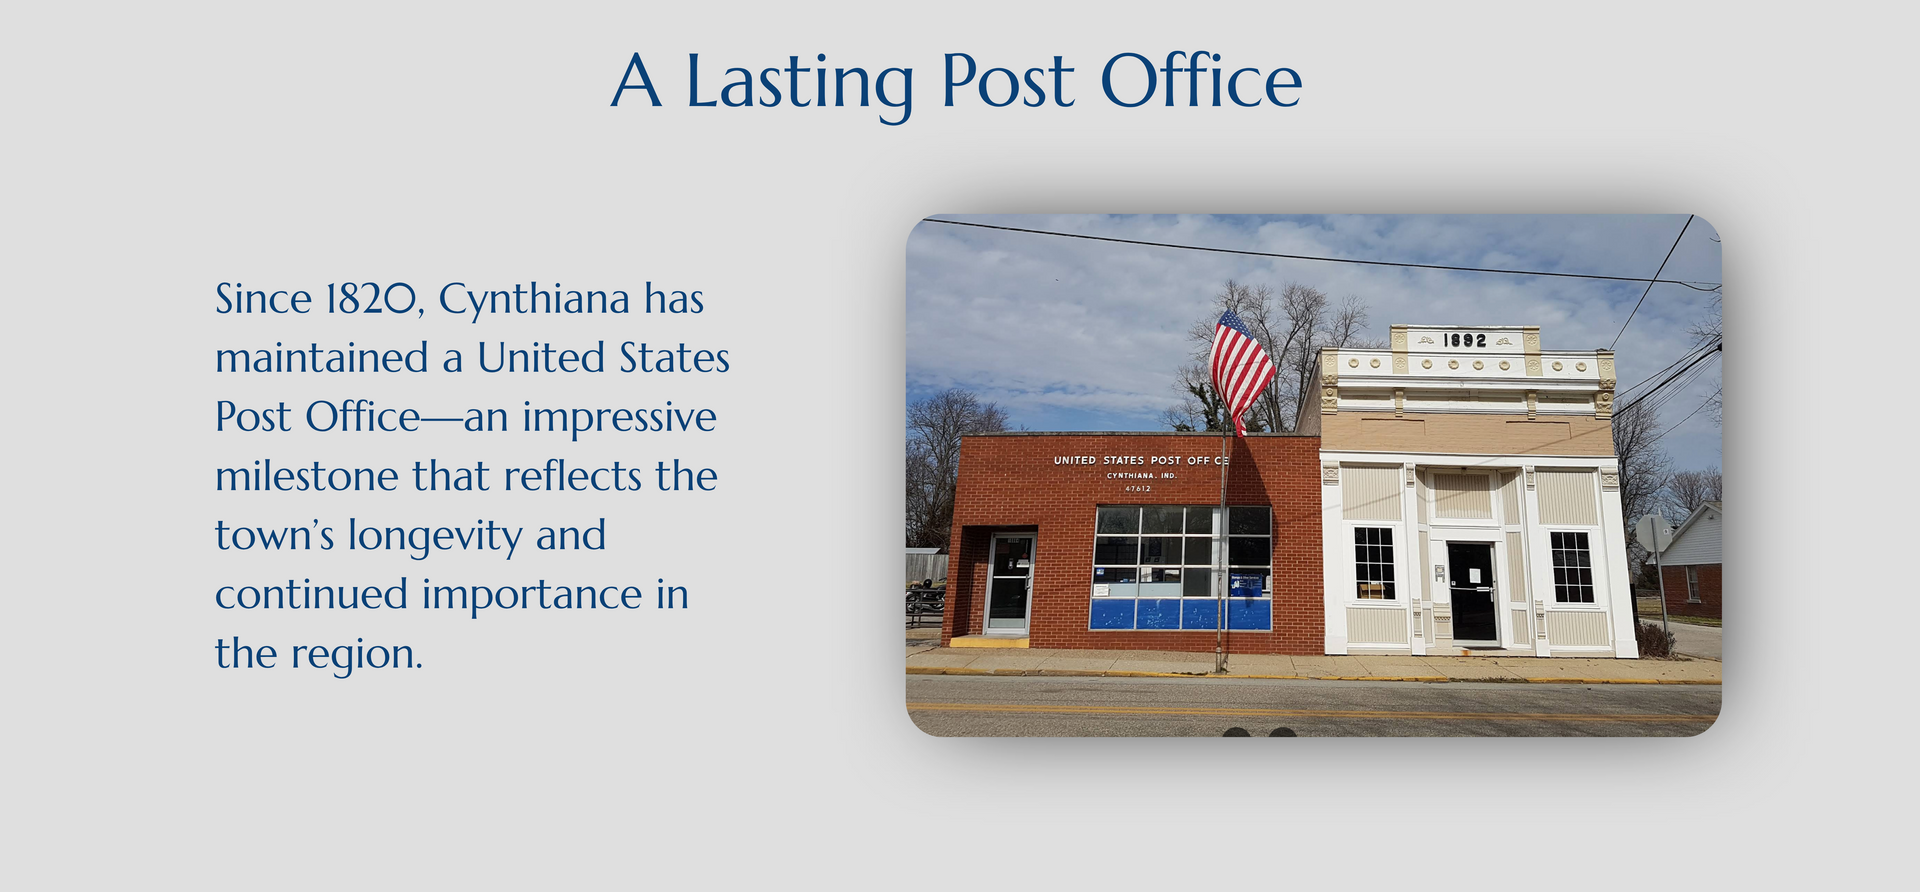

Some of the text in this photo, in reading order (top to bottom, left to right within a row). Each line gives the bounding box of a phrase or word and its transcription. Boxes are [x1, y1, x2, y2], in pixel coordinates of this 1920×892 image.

[1444, 333, 1487, 348] 1892
[1054, 456, 1096, 465] UNITED
[1103, 456, 1144, 465] STATES
[1150, 456, 1182, 465] POST
